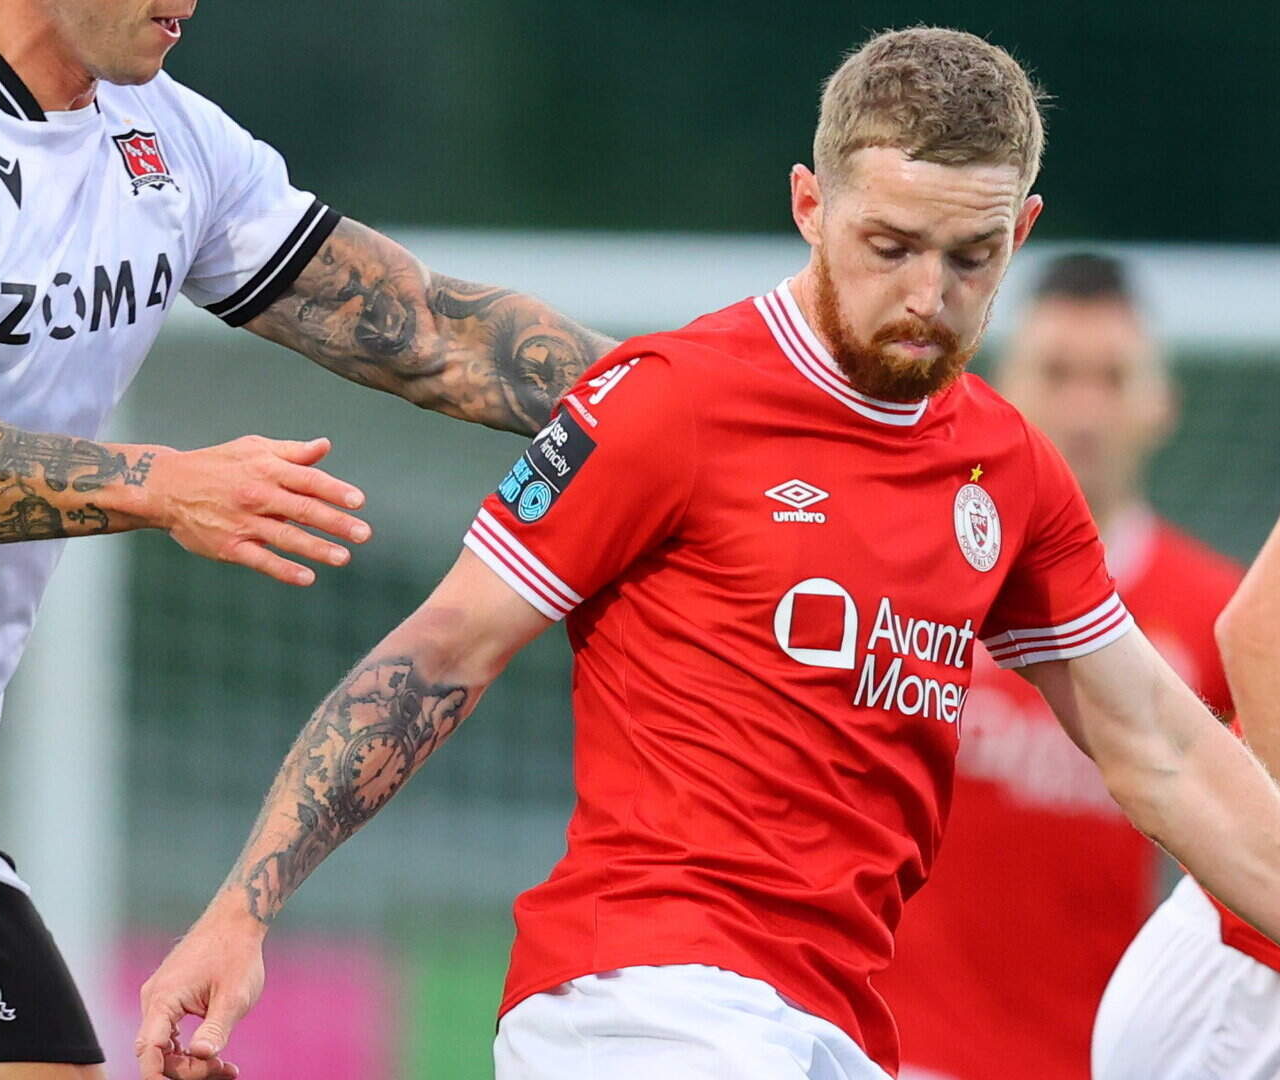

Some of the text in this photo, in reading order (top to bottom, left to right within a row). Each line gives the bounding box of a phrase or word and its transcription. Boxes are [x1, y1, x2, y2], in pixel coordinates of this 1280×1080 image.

[550, 422, 569, 448] sse
[772, 508, 826, 524] umbro
[867, 596, 974, 668] Avant
